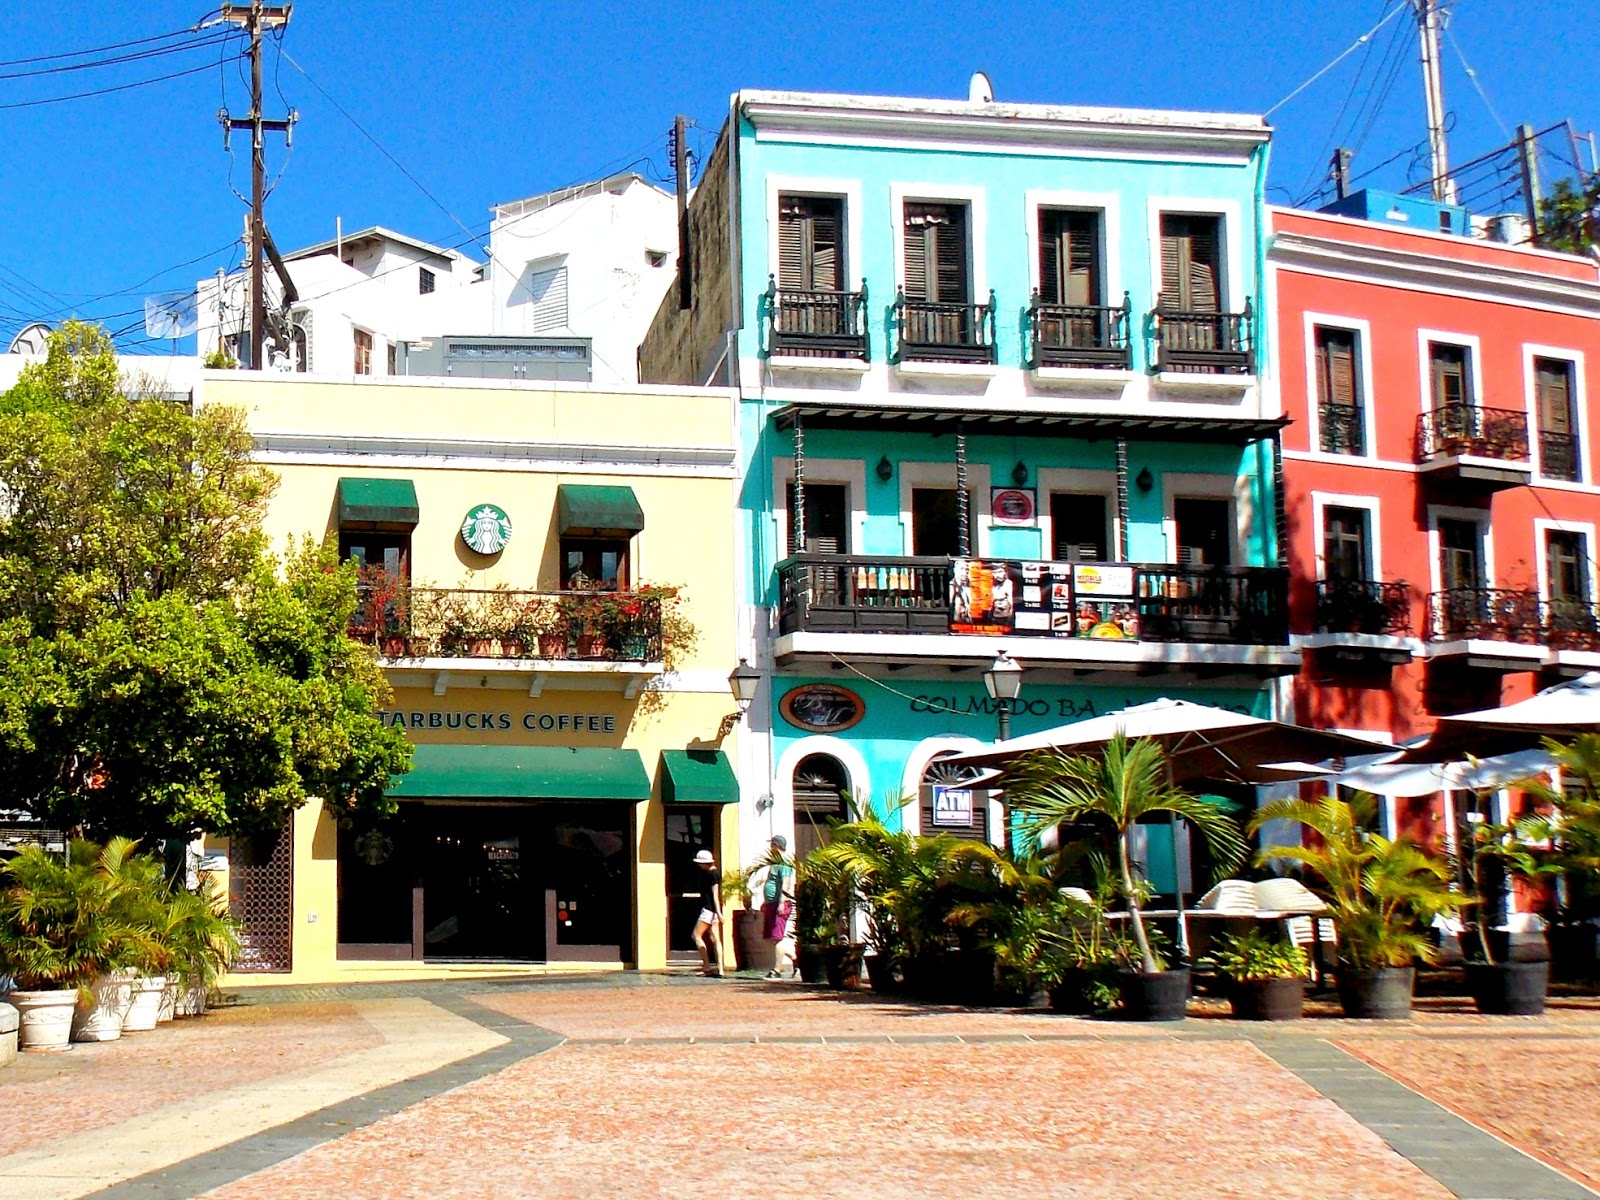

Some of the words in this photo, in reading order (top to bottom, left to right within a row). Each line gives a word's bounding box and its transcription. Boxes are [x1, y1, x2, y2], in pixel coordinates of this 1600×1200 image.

[369, 711, 512, 730] TARBUCKS
[522, 713, 616, 733] COFFEE
[936, 792, 970, 811] ATM
